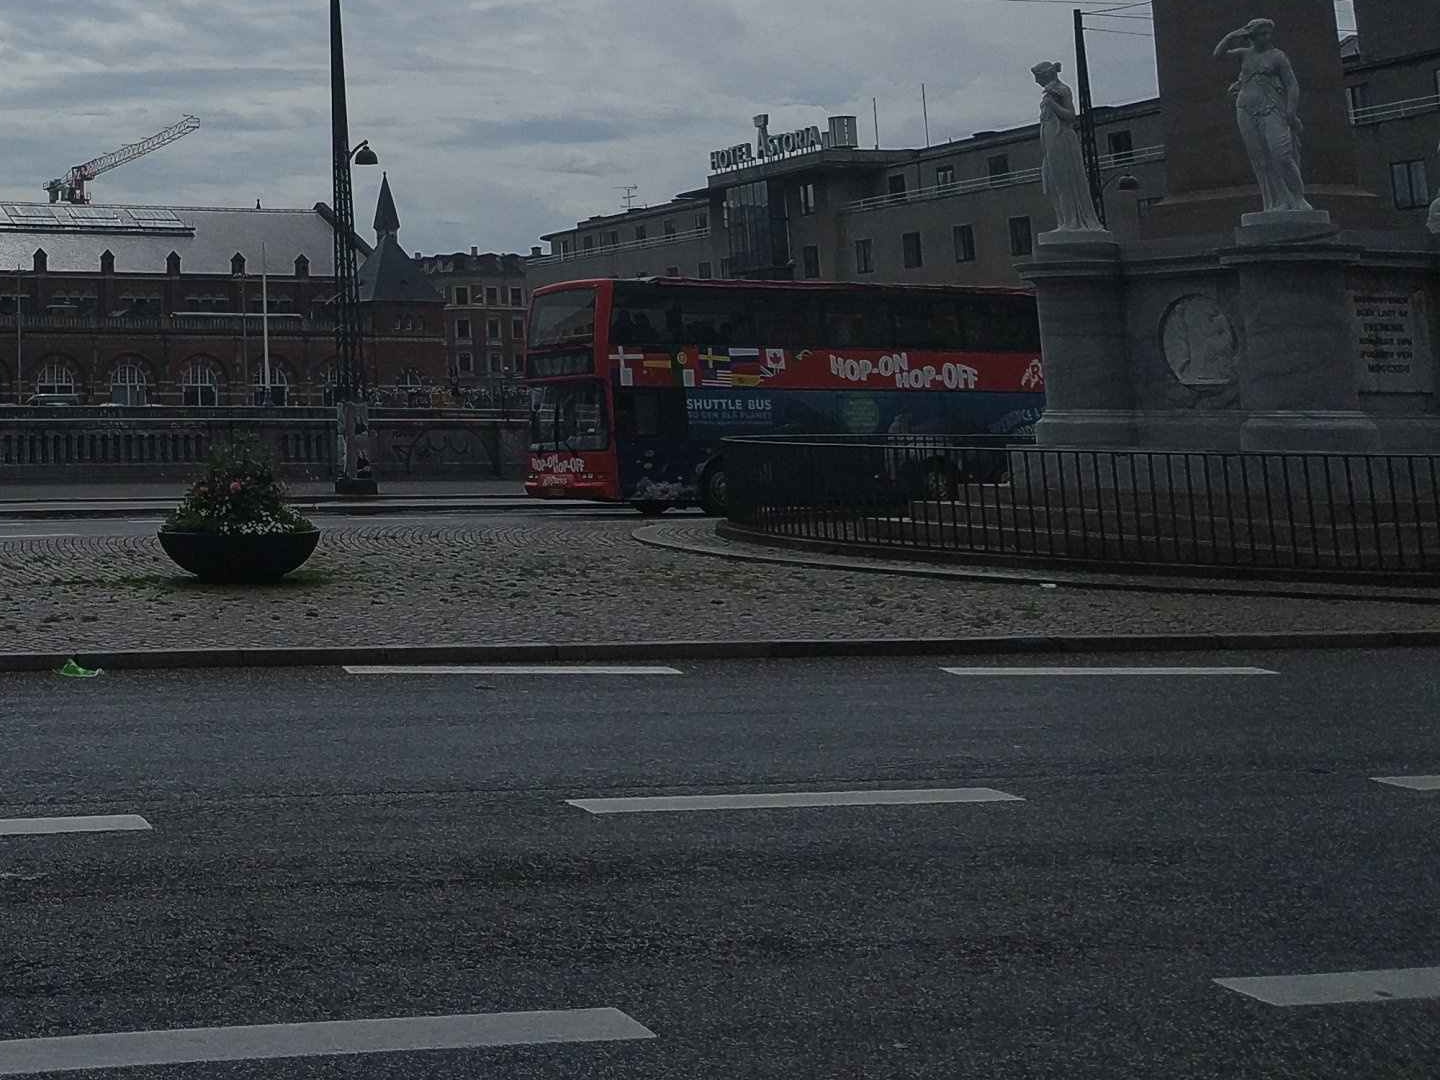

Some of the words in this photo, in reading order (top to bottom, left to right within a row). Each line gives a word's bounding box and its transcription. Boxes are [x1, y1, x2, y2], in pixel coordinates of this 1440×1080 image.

[709, 142, 756, 170] HOTEL
[756, 125, 822, 160] ASTORIA
[829, 352, 909, 381] HOP-ON
[895, 362, 980, 389] HOP-OFF
[686, 399, 743, 410] SHUTTLE
[748, 399, 773, 410] BUS
